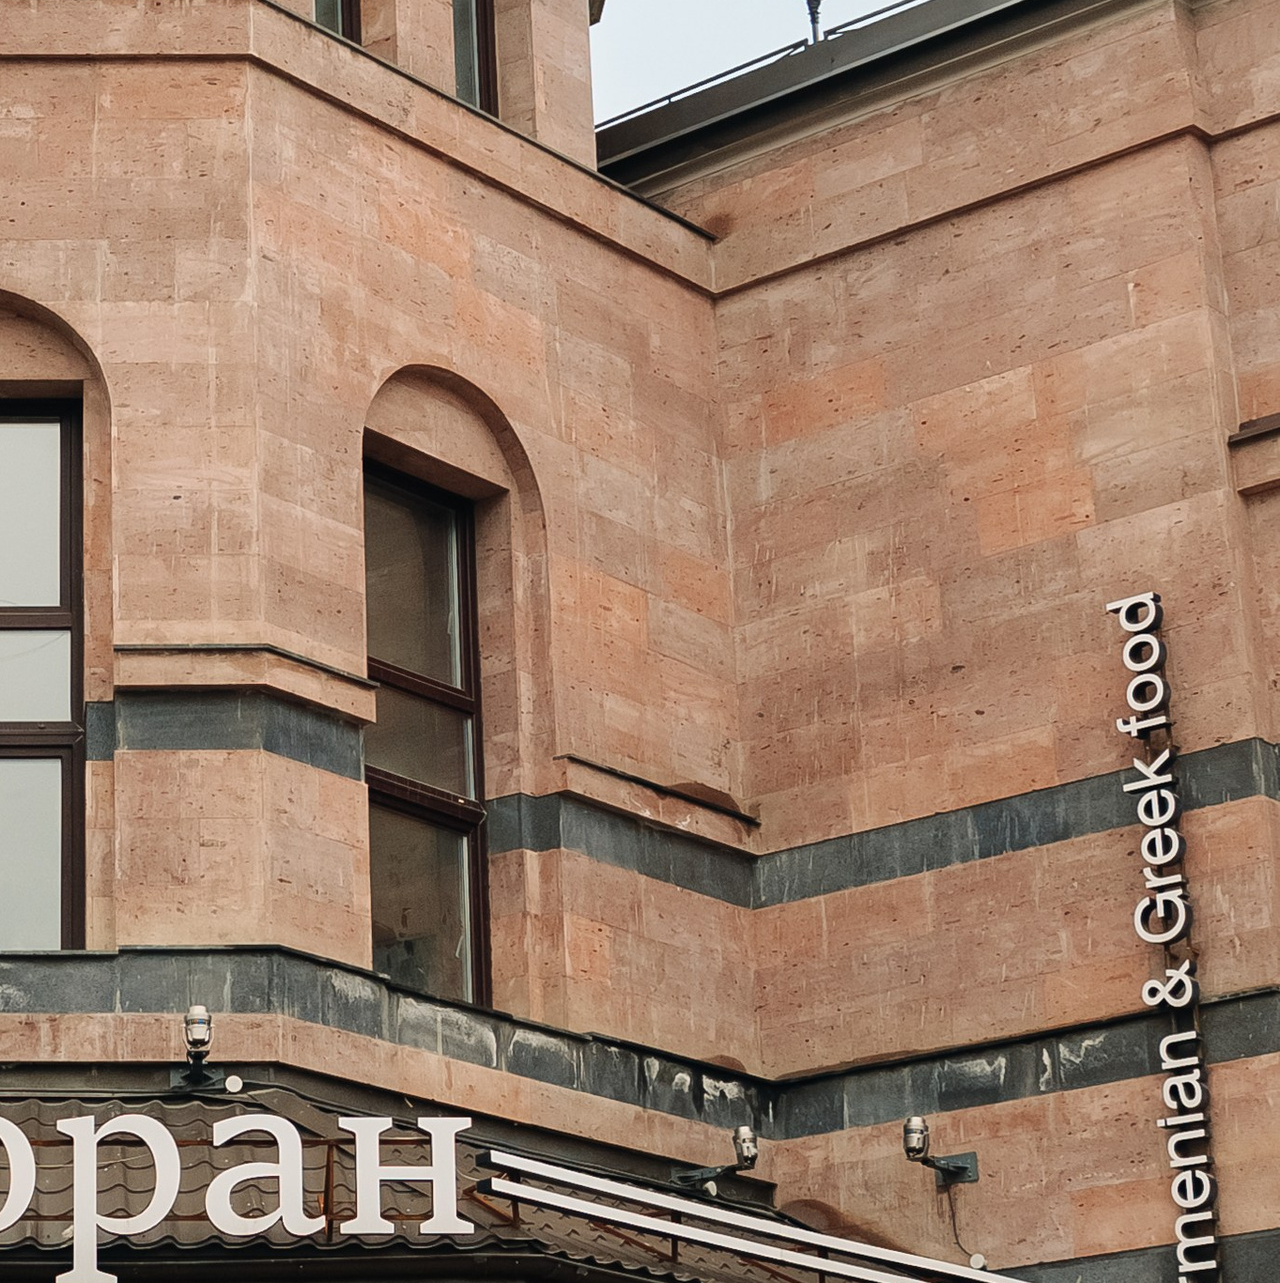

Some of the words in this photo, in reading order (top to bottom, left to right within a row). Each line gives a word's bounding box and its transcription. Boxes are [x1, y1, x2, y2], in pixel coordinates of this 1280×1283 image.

[1105, 590, 1168, 739] food
[1122, 748, 1188, 945] Greek
[1141, 958, 1193, 1009] &
